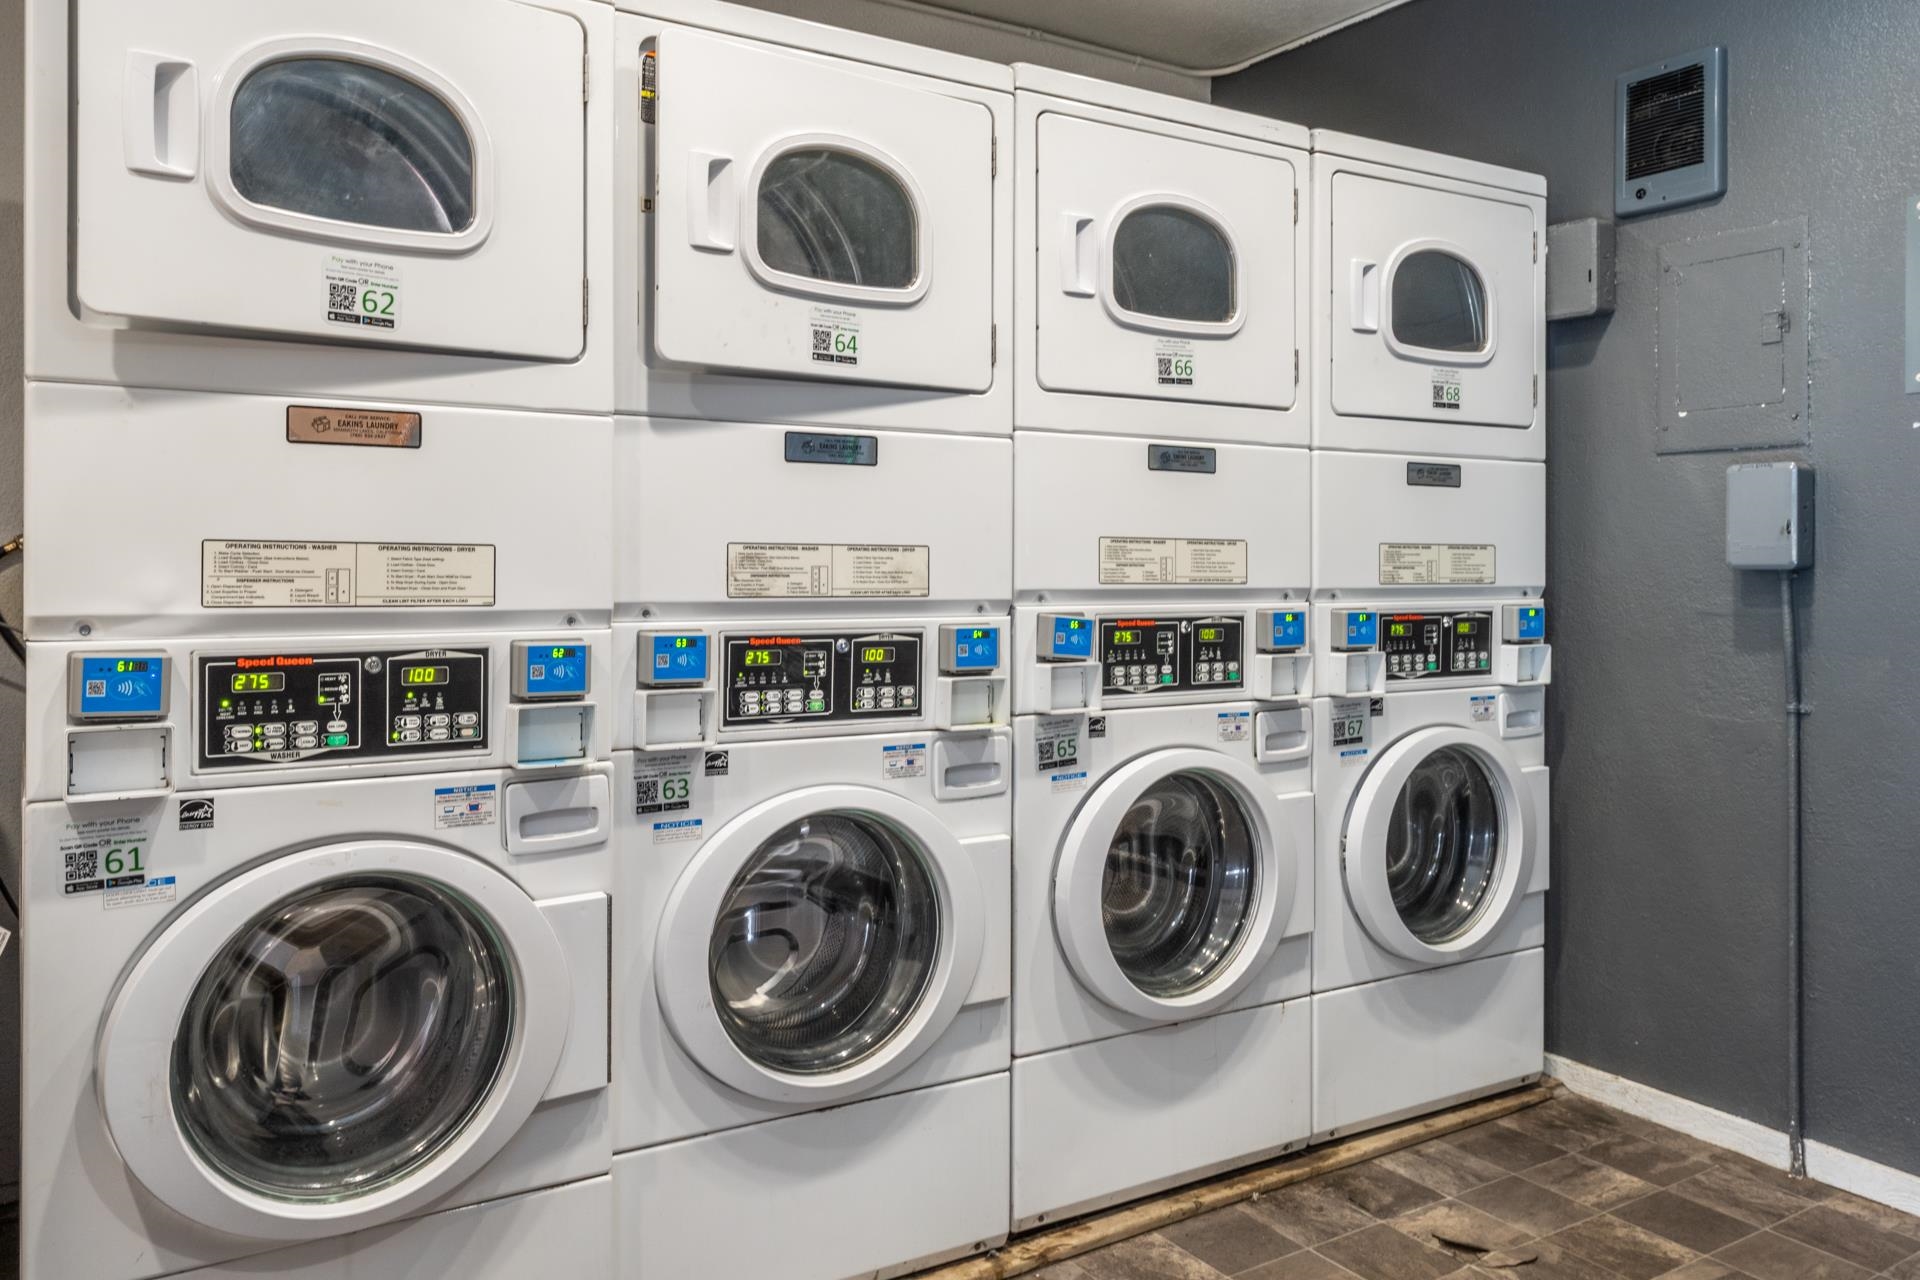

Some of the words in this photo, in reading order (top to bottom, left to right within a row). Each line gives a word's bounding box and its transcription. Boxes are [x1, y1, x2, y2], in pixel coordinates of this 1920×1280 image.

[374, 262, 394, 270] Phone
[362, 290, 395, 316] 62
[835, 333, 858, 354] 64
[1175, 360, 1192, 376] 66
[1446, 387, 1460, 401] 68
[338, 419, 363, 428] EAKINS
[366, 421, 399, 430] LAUNDRY
[1114, 631, 1131, 643] 275
[1201, 629, 1215, 639] 100
[676, 638, 687, 648] 63
[750, 638, 775, 646] Speed
[552, 648, 564, 658] 62
[746, 652, 769, 664] 275
[864, 649, 884, 661] 100
[117, 660, 133, 672] 61
[237, 657, 274, 668] Speed
[276, 657, 313, 666] Queen
[409, 668, 434, 682] 100
[235, 674, 269, 690] 275
[1348, 720, 1363, 736] 67
[1057, 739, 1076, 757] 65
[663, 778, 689, 800] 63
[66, 822, 80, 830] Pay
[82, 819, 98, 827] with
[100, 818, 115, 827] your
[660, 820, 696, 829] NOTICE
[105, 847, 144, 874] 61
